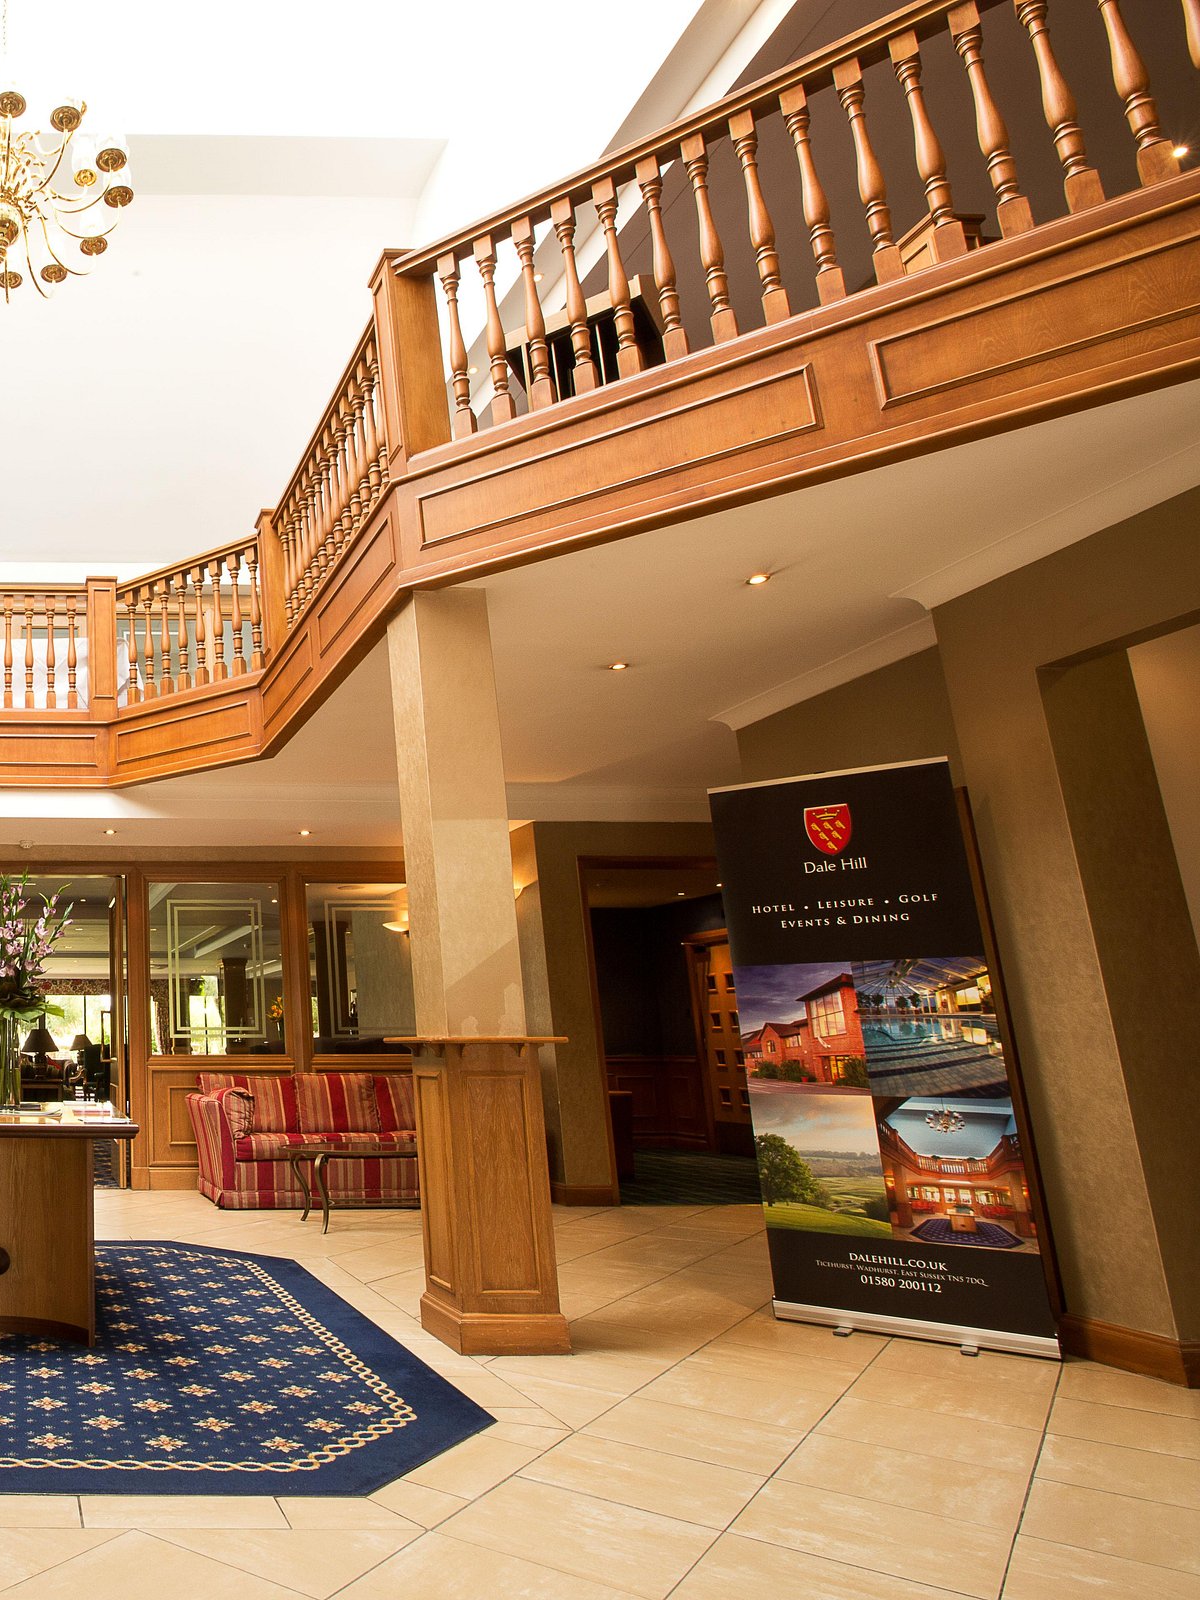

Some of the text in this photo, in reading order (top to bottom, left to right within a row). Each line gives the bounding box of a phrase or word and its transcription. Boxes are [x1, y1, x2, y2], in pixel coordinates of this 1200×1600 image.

[804, 856, 867, 874] Dale Hill
[752, 893, 939, 914] HOTEL LEISURE GOLF
[781, 912, 910, 929] EVENTS & DINING
[849, 1252, 948, 1271] DALEHILL.CO.UK
[860, 1274, 942, 1294] 01580 200112
[900, 1269, 918, 1279] EAST
[919, 1271, 947, 1282] SUSSEX
[947, 1274, 965, 1285] TN5
[965, 1276, 990, 1288] 7DQ
